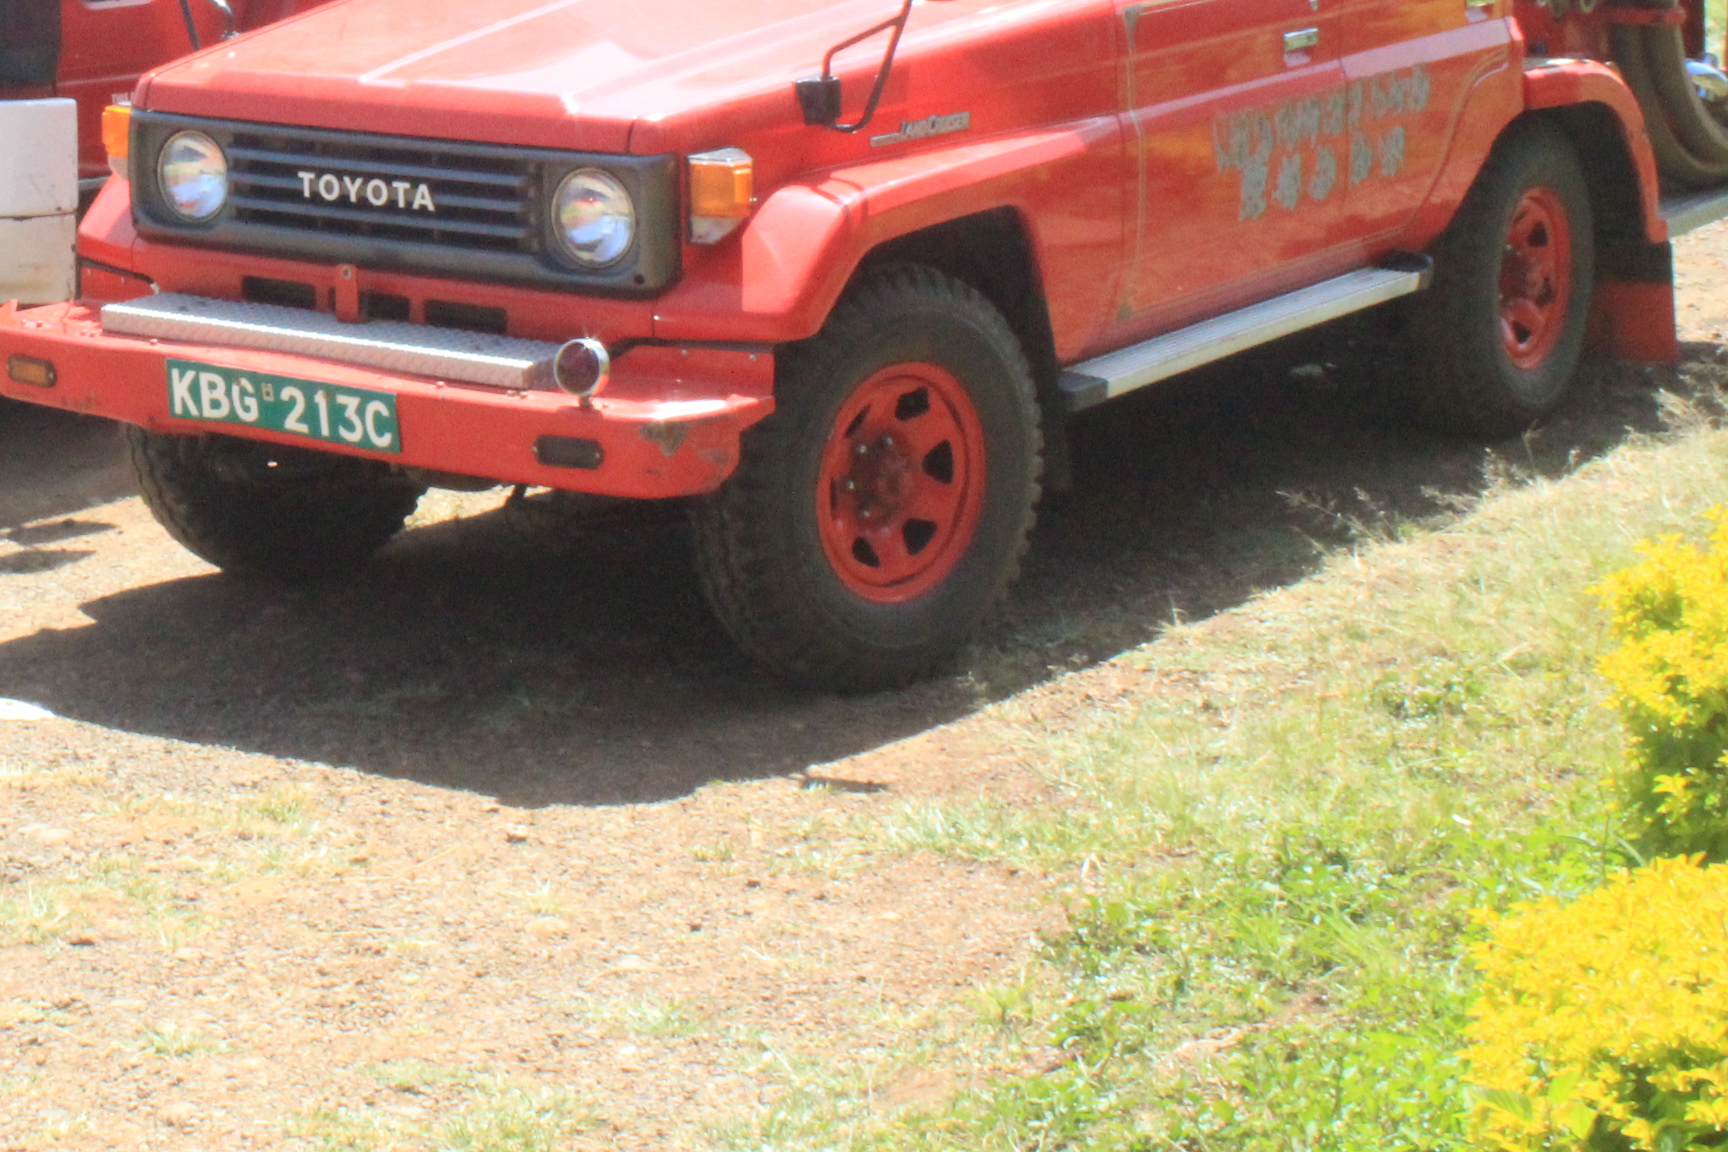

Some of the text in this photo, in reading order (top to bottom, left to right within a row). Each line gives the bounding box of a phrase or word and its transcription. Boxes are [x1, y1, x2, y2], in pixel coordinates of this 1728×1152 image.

[297, 170, 436, 213] TOYOTA
[170, 367, 393, 449] KBG 213C
